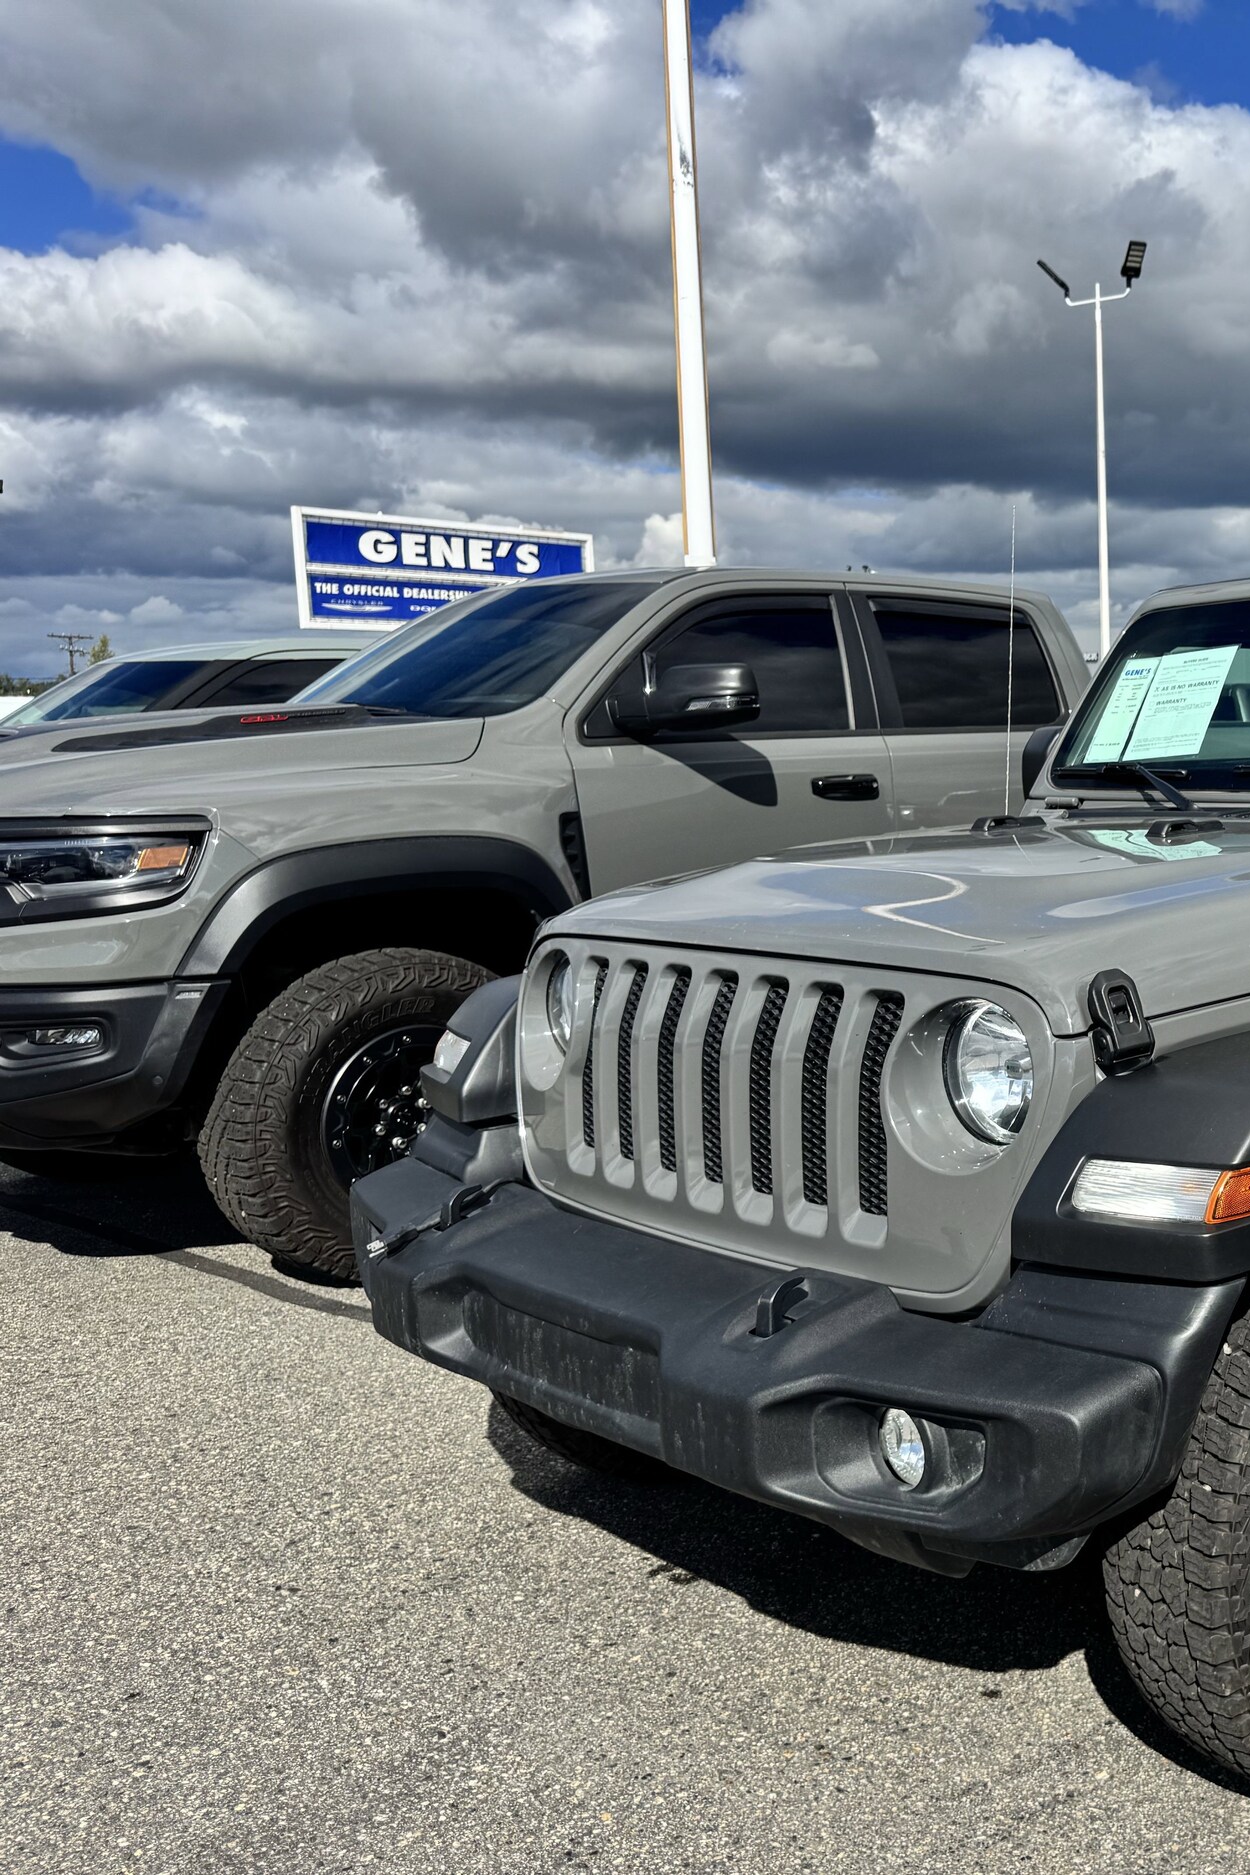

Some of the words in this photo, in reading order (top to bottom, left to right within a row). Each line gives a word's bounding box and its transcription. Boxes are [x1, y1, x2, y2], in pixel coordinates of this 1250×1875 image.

[358, 530, 541, 574] GENE'S
[314, 582, 339, 594] THE
[343, 583, 400, 598] OFFICIAL
[1125, 668, 1152, 677] GENE'S
[1187, 680, 1220, 688] WARRANTY
[1156, 697, 1187, 706] WARRANTY
